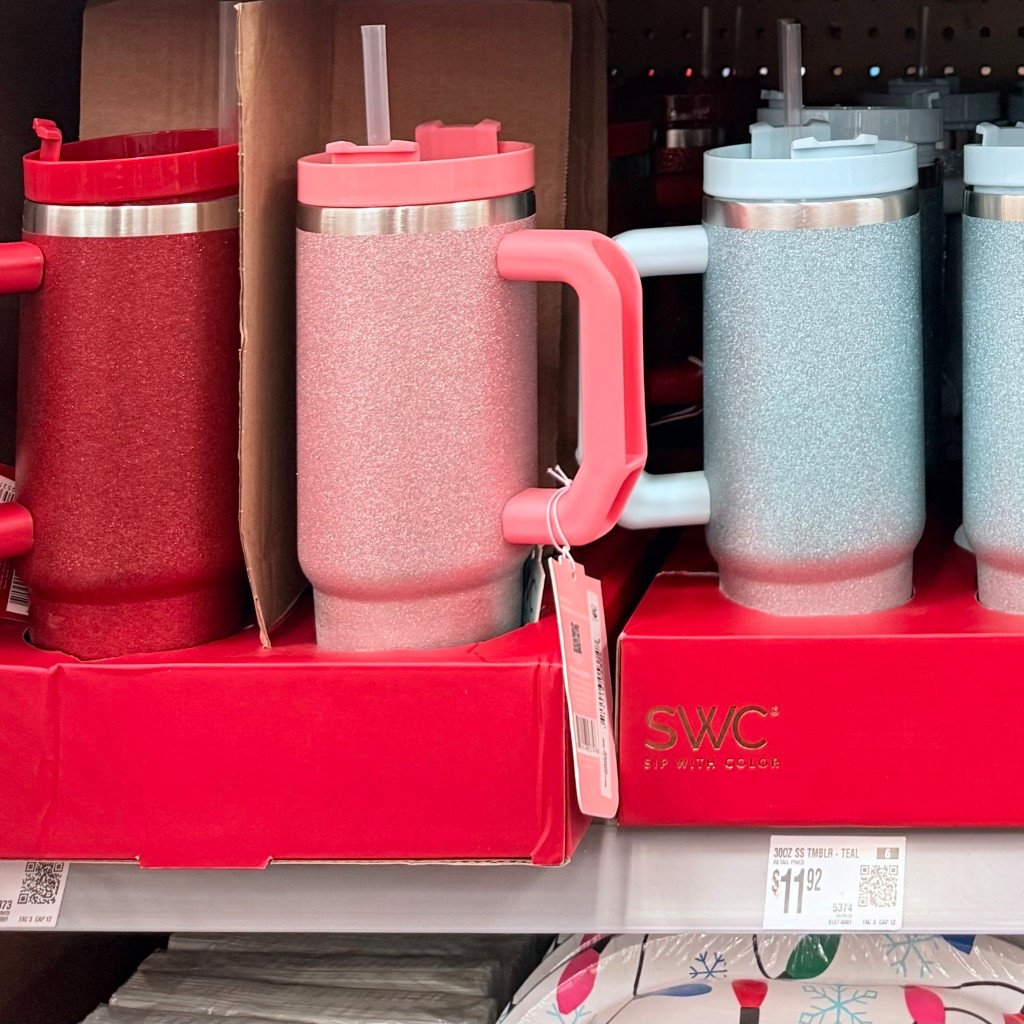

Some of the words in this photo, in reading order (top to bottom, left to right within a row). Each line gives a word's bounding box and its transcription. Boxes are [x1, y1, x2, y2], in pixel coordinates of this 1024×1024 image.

[644, 705, 767, 751] SWC
[644, 759, 669, 770] SIP
[677, 759, 716, 770] WITH
[725, 758, 780, 770] COLOR
[795, 847, 805, 858] SS
[807, 848, 833, 858] TMBLR
[841, 848, 860, 858] TEAL
[884, 849, 891, 859] 6
[832, 903, 853, 913] 5374
